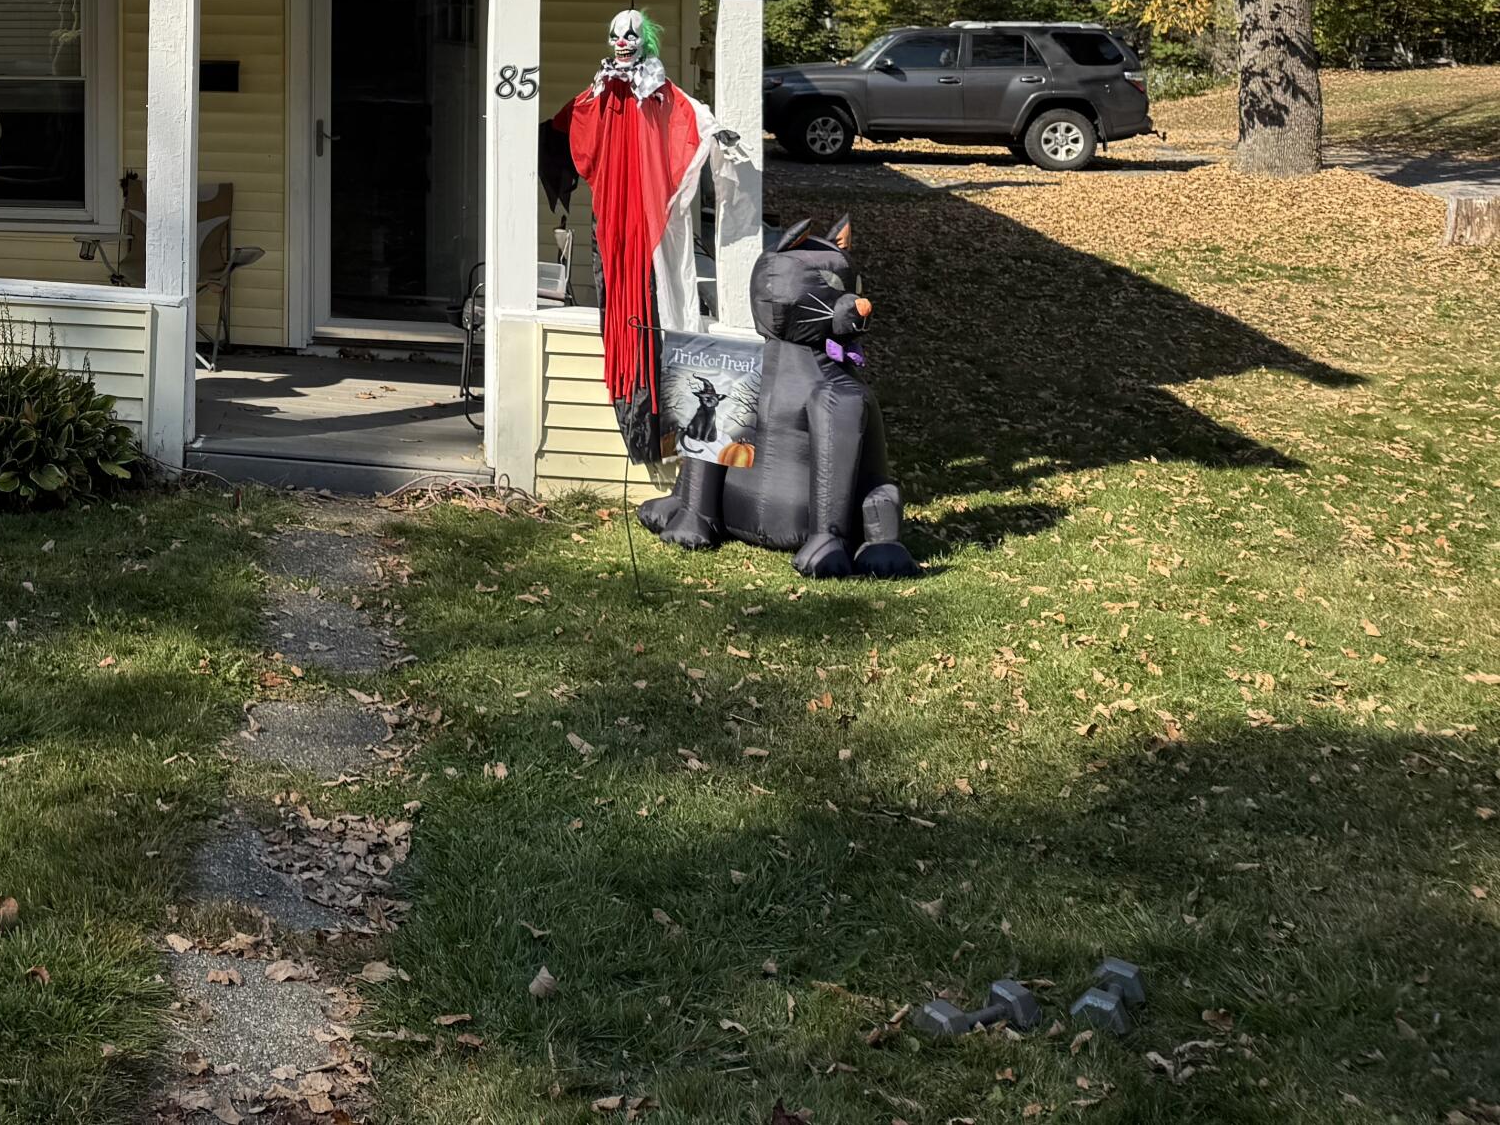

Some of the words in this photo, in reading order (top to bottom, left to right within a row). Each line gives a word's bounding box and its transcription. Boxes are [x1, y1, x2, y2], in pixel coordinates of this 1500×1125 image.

[495, 65, 540, 100] 85
[672, 348, 709, 367] Trick
[709, 357, 720, 367] or
[720, 354, 756, 373] Treat
